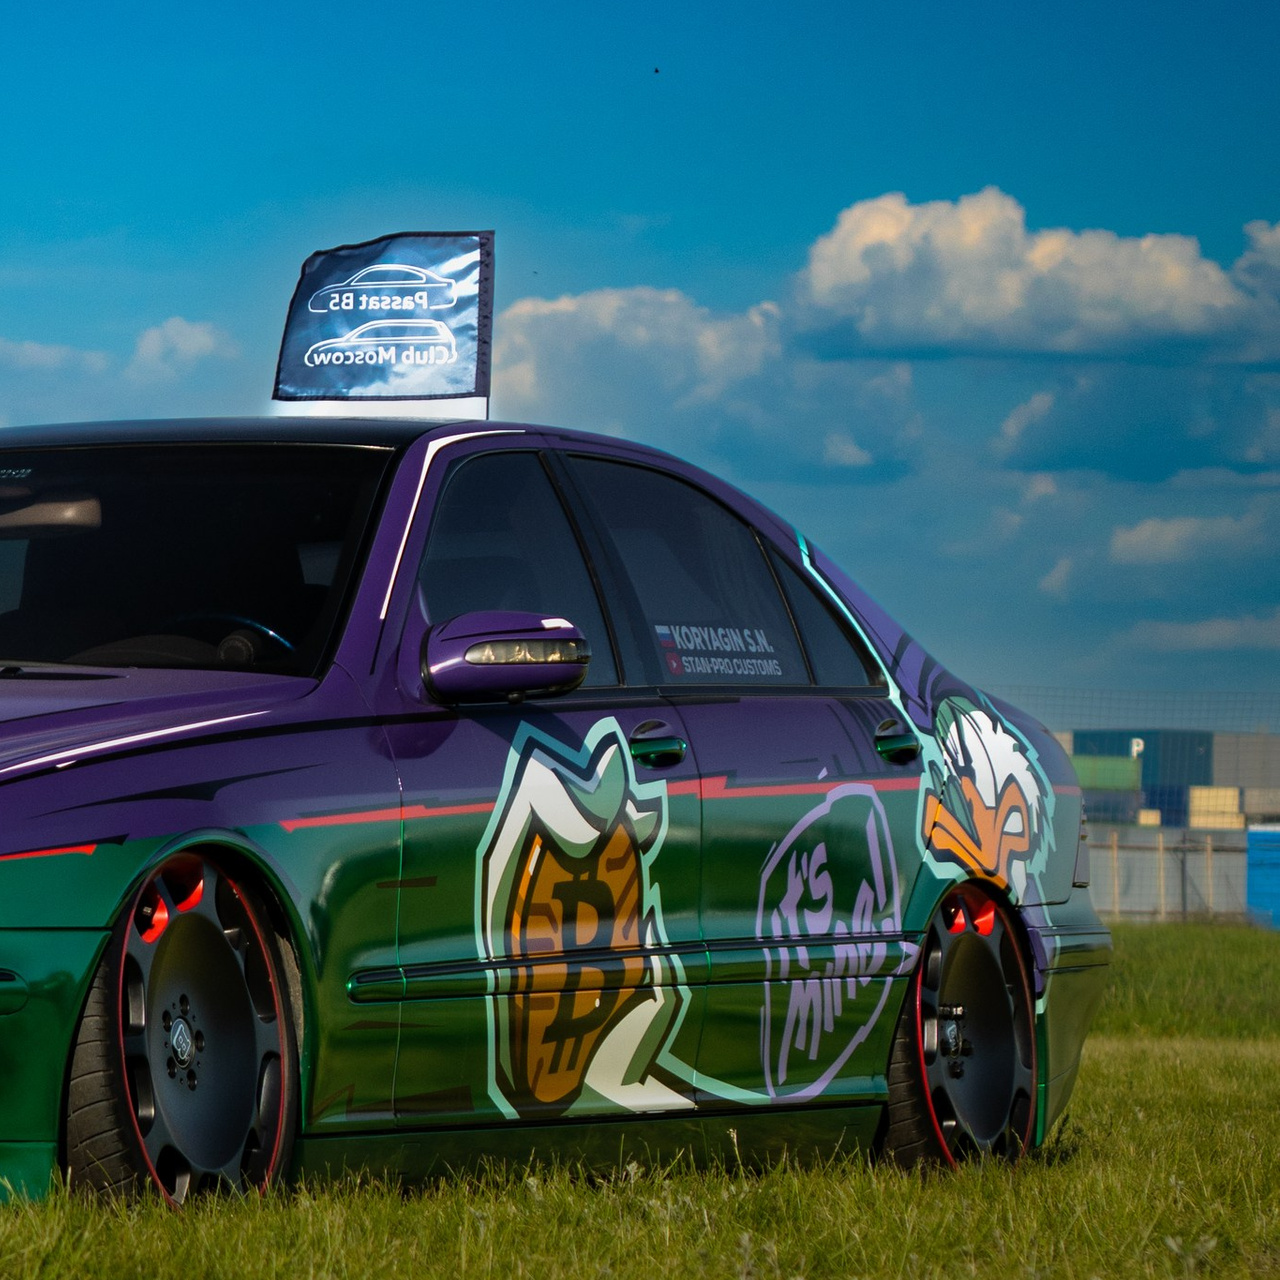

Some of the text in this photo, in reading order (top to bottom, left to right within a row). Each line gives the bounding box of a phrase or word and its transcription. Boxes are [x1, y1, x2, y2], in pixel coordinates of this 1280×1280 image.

[670, 625, 775, 653] KORYAGIN S.N.
[681, 656, 782, 676] STAN-PRO CUSTOMS
